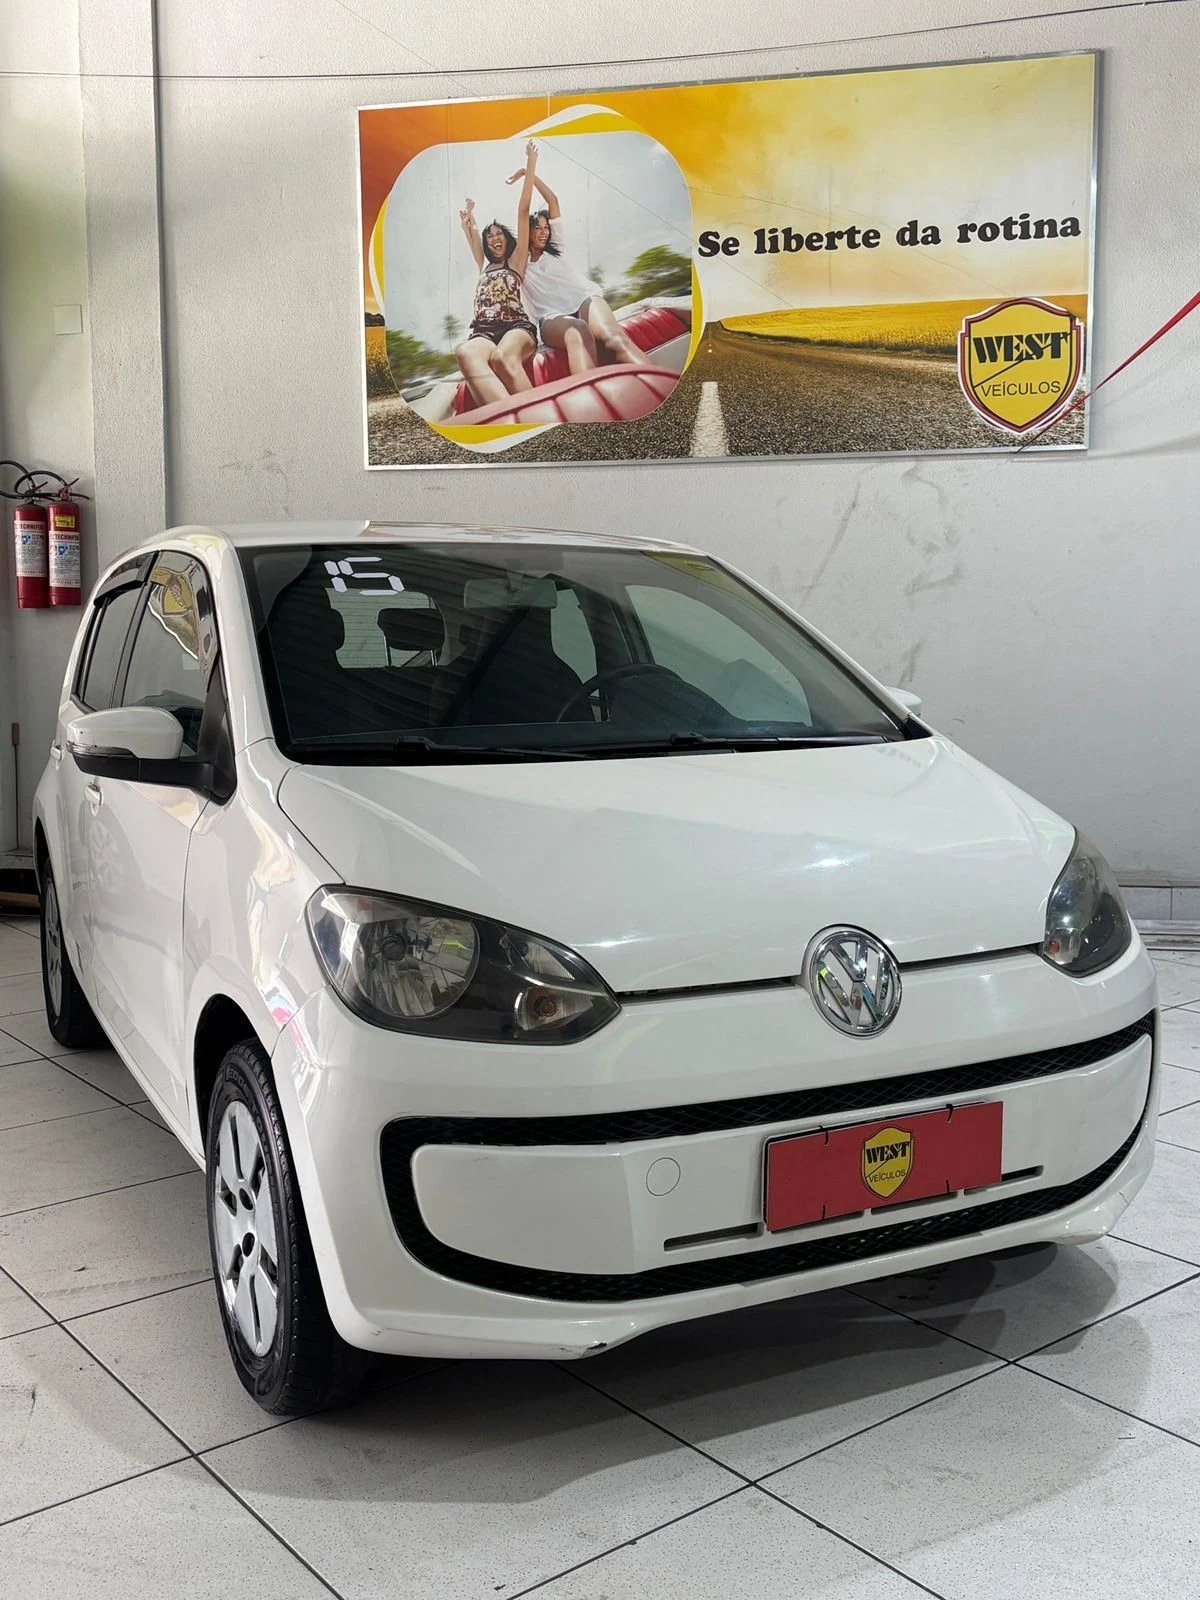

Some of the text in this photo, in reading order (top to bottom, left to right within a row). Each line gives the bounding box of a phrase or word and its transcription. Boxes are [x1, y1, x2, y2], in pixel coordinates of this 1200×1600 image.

[698, 213, 1081, 257] Se liberte da rotina
[972, 331, 1069, 364] WEST
[981, 380, 1061, 397] VEÍCULOS
[323, 556, 405, 596] 15
[866, 1141, 911, 1164] WEST
[869, 1168, 906, 1183] VEÍCULOS
